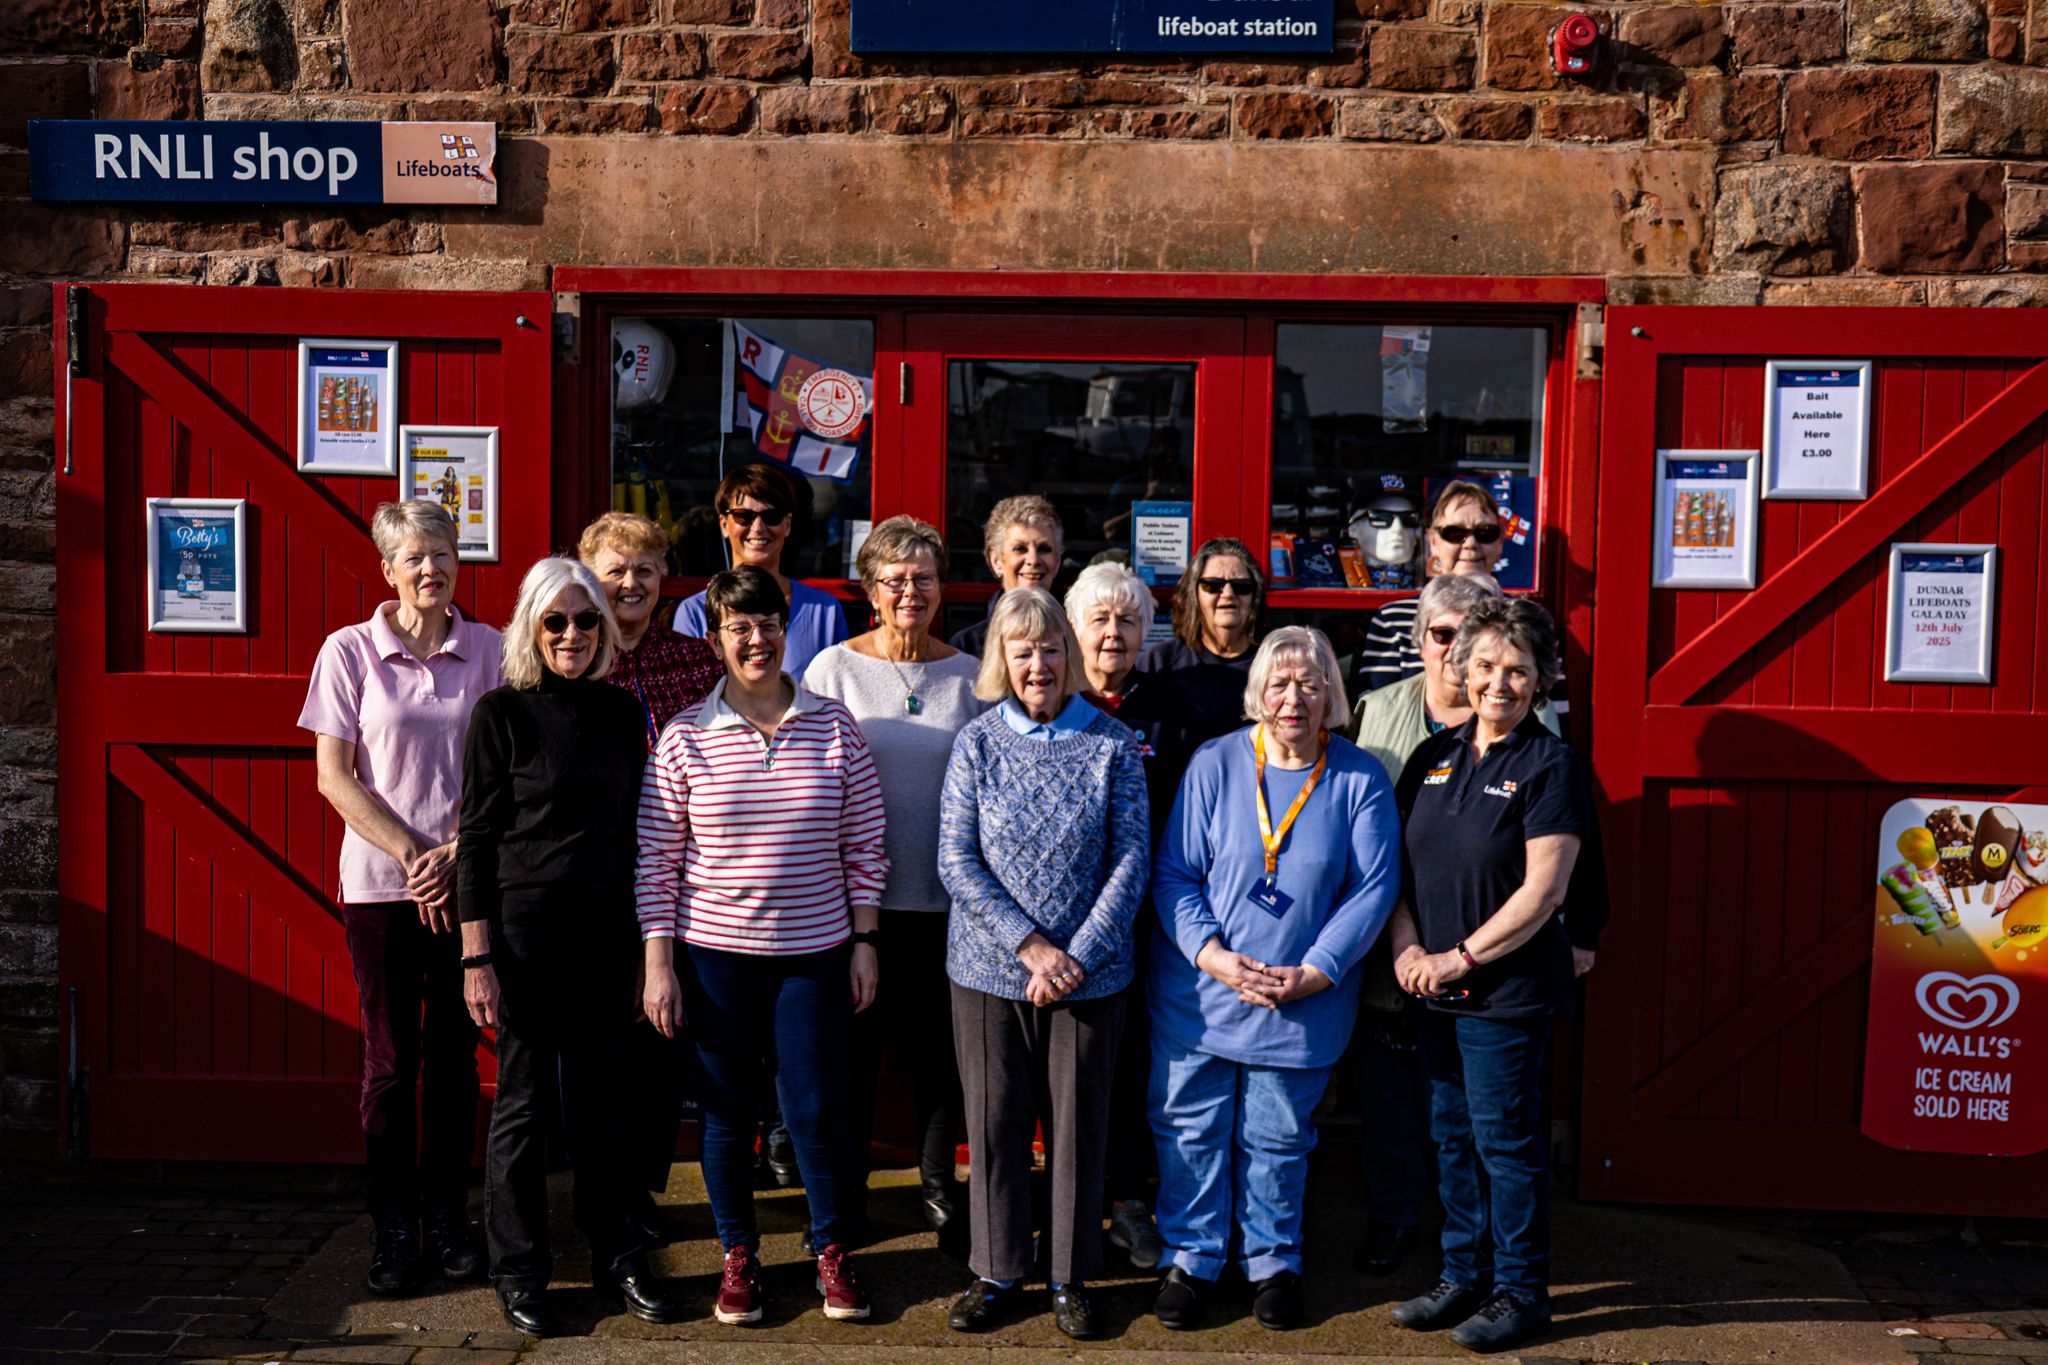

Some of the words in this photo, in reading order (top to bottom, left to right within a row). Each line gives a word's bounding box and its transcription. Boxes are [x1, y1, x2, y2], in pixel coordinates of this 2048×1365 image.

[1158, 16, 1238, 36] lifeboat
[1243, 17, 1317, 36] station
[94, 133, 214, 180] RNLI
[232, 131, 358, 196] shop
[397, 160, 482, 177] Lifeboats
[743, 335, 762, 368] R
[634, 344, 650, 383] RNLI
[806, 370, 861, 392] EMERGENCY?
[1807, 392, 1829, 401] Bait
[799, 396, 808, 418] CALL
[818, 403, 864, 437] COASTGUARD
[1792, 411, 1843, 420] Available
[1804, 430, 1831, 438] Here
[1802, 449, 1832, 457] £3.00
[177, 525, 219, 551] Betty's
[183, 551, 194, 561] 5p
[1917, 585, 1964, 595] DUNBAR
[1909, 598, 1971, 607] LIFEBOATS
[1911, 610, 1943, 619] GALA
[1945, 610, 1968, 619] DAY
[1915, 623, 1938, 632] 12th
[1941, 623, 1964, 635] July
[1926, 637, 1951, 646] 2025
[1941, 846, 1974, 859] FEAST
[1987, 849, 2001, 859] M
[1917, 1031, 2011, 1059] WALL'S
[1915, 1066, 1943, 1091] ICE
[1948, 1068, 2012, 1095] CREAM
[1913, 1094, 1961, 1119] SOLD
[1966, 1097, 2010, 1122] HERE
